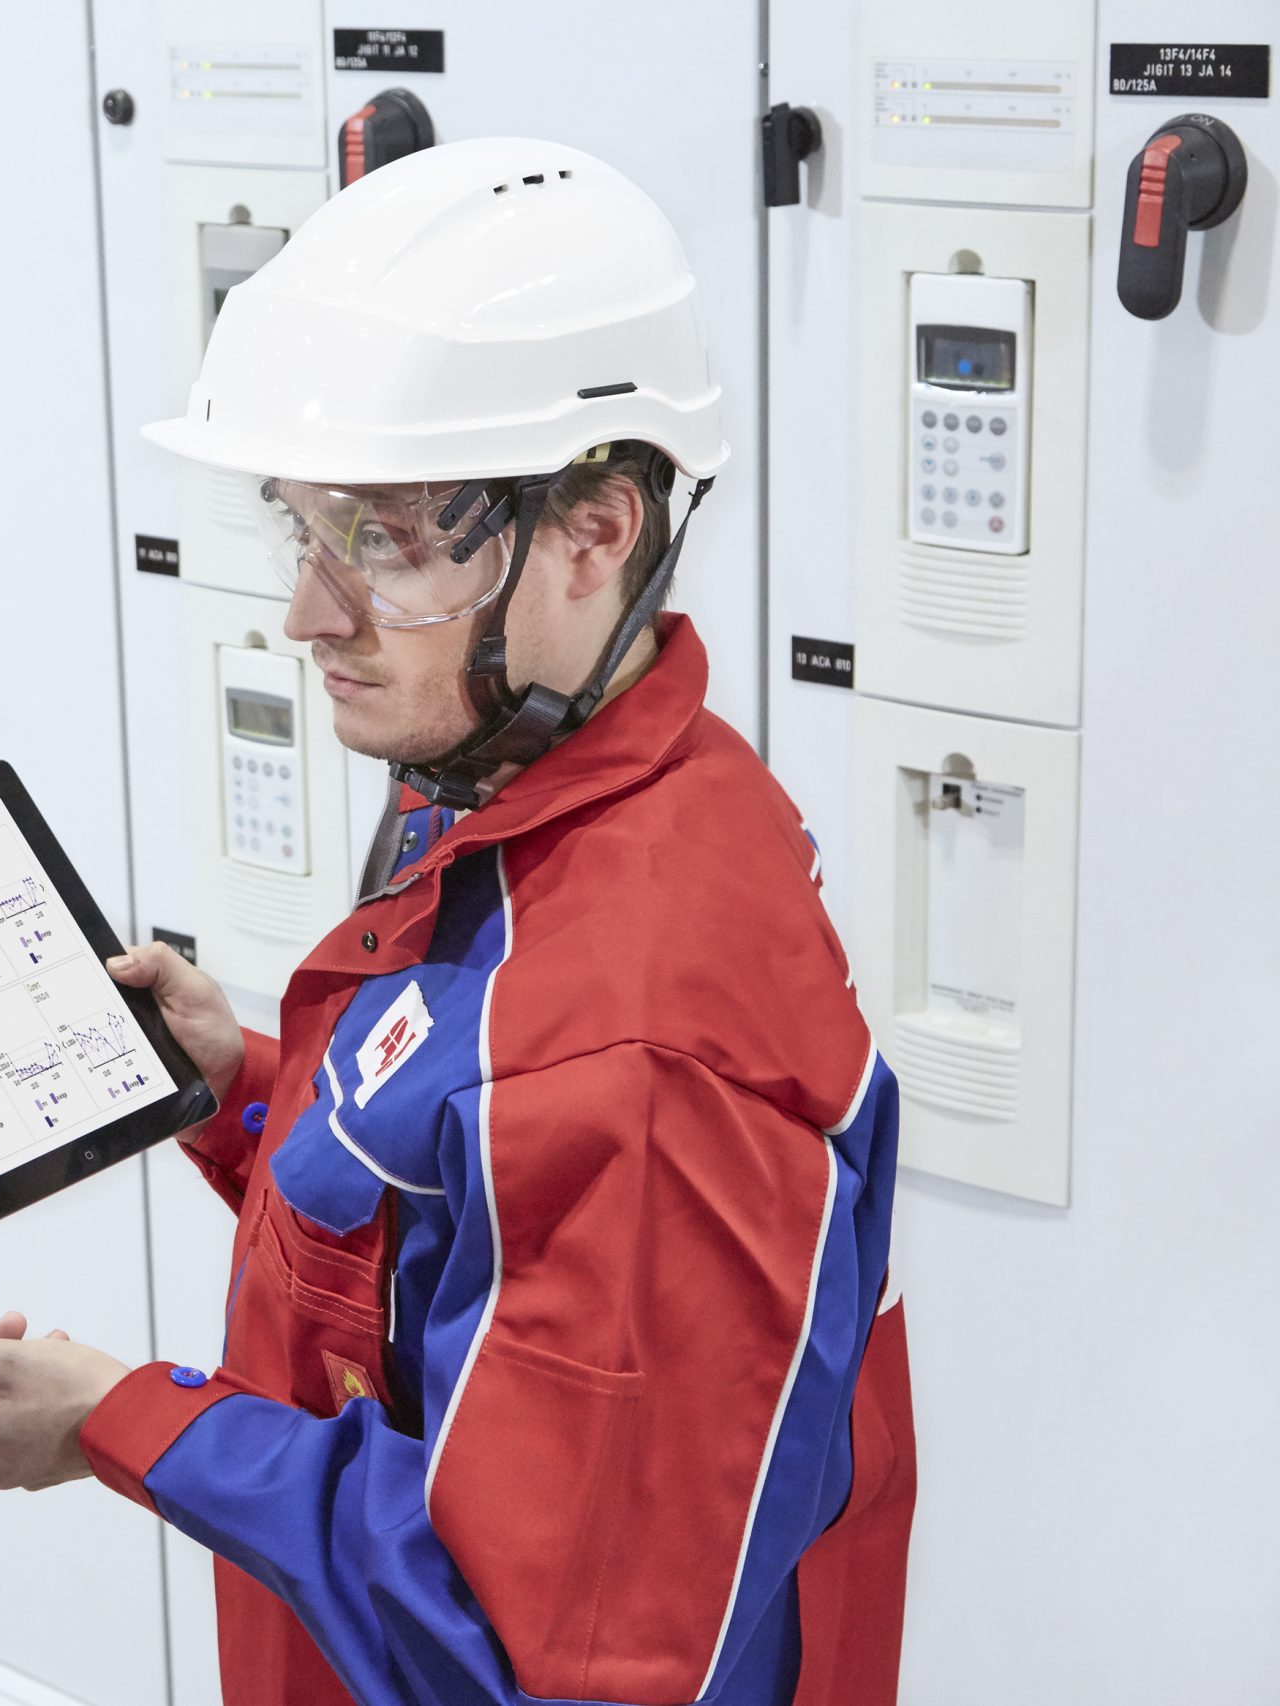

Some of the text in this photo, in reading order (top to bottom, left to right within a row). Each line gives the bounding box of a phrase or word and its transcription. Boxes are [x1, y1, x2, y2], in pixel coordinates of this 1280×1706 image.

[1159, 48, 1216, 61] 13F4/14F4
[1143, 64, 1232, 77] JIGIT 13 JA 14
[1113, 78, 1157, 91] 80/125A
[796, 652, 807, 665] 13
[811, 655, 831, 668] ACA
